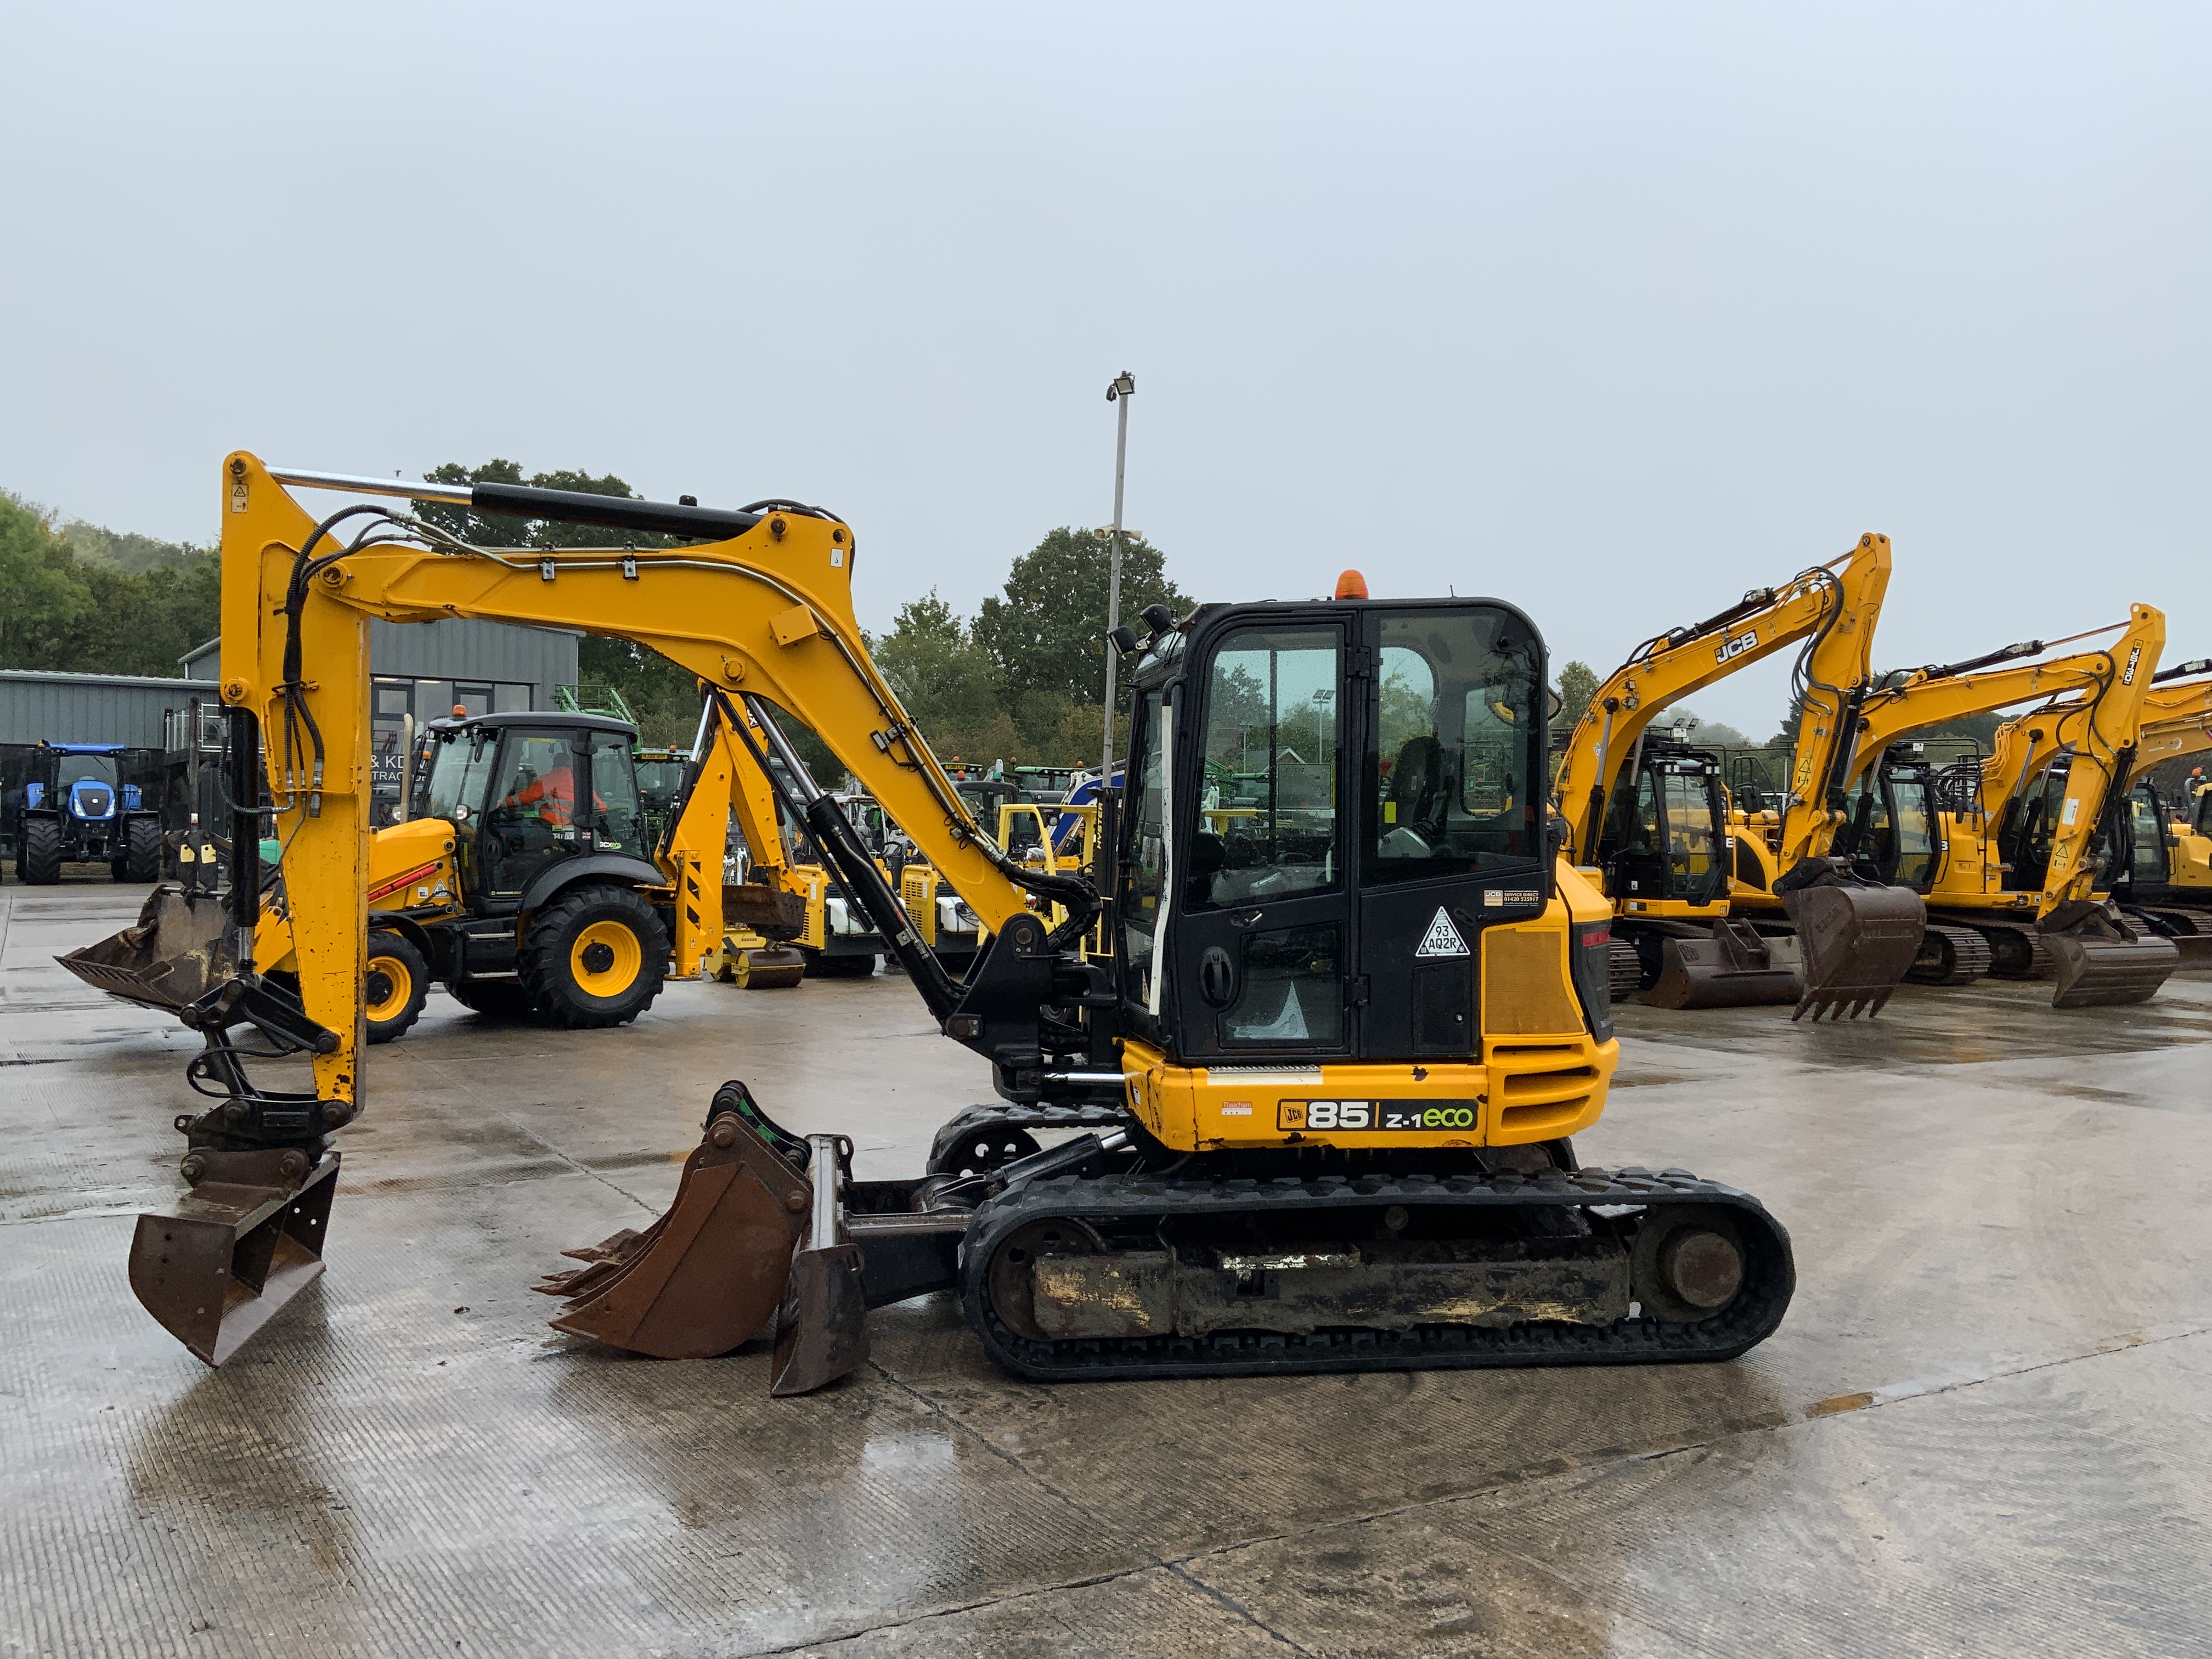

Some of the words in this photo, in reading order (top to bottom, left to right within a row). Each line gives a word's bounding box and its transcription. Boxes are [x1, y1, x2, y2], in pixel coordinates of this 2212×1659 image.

[1717, 631, 1757, 663] JCB
[1436, 926, 1448, 937] 93
[1429, 938, 1457, 949] AQ2R
[1287, 1109, 1302, 1121] JCB
[1308, 1101, 1369, 1128] 85
